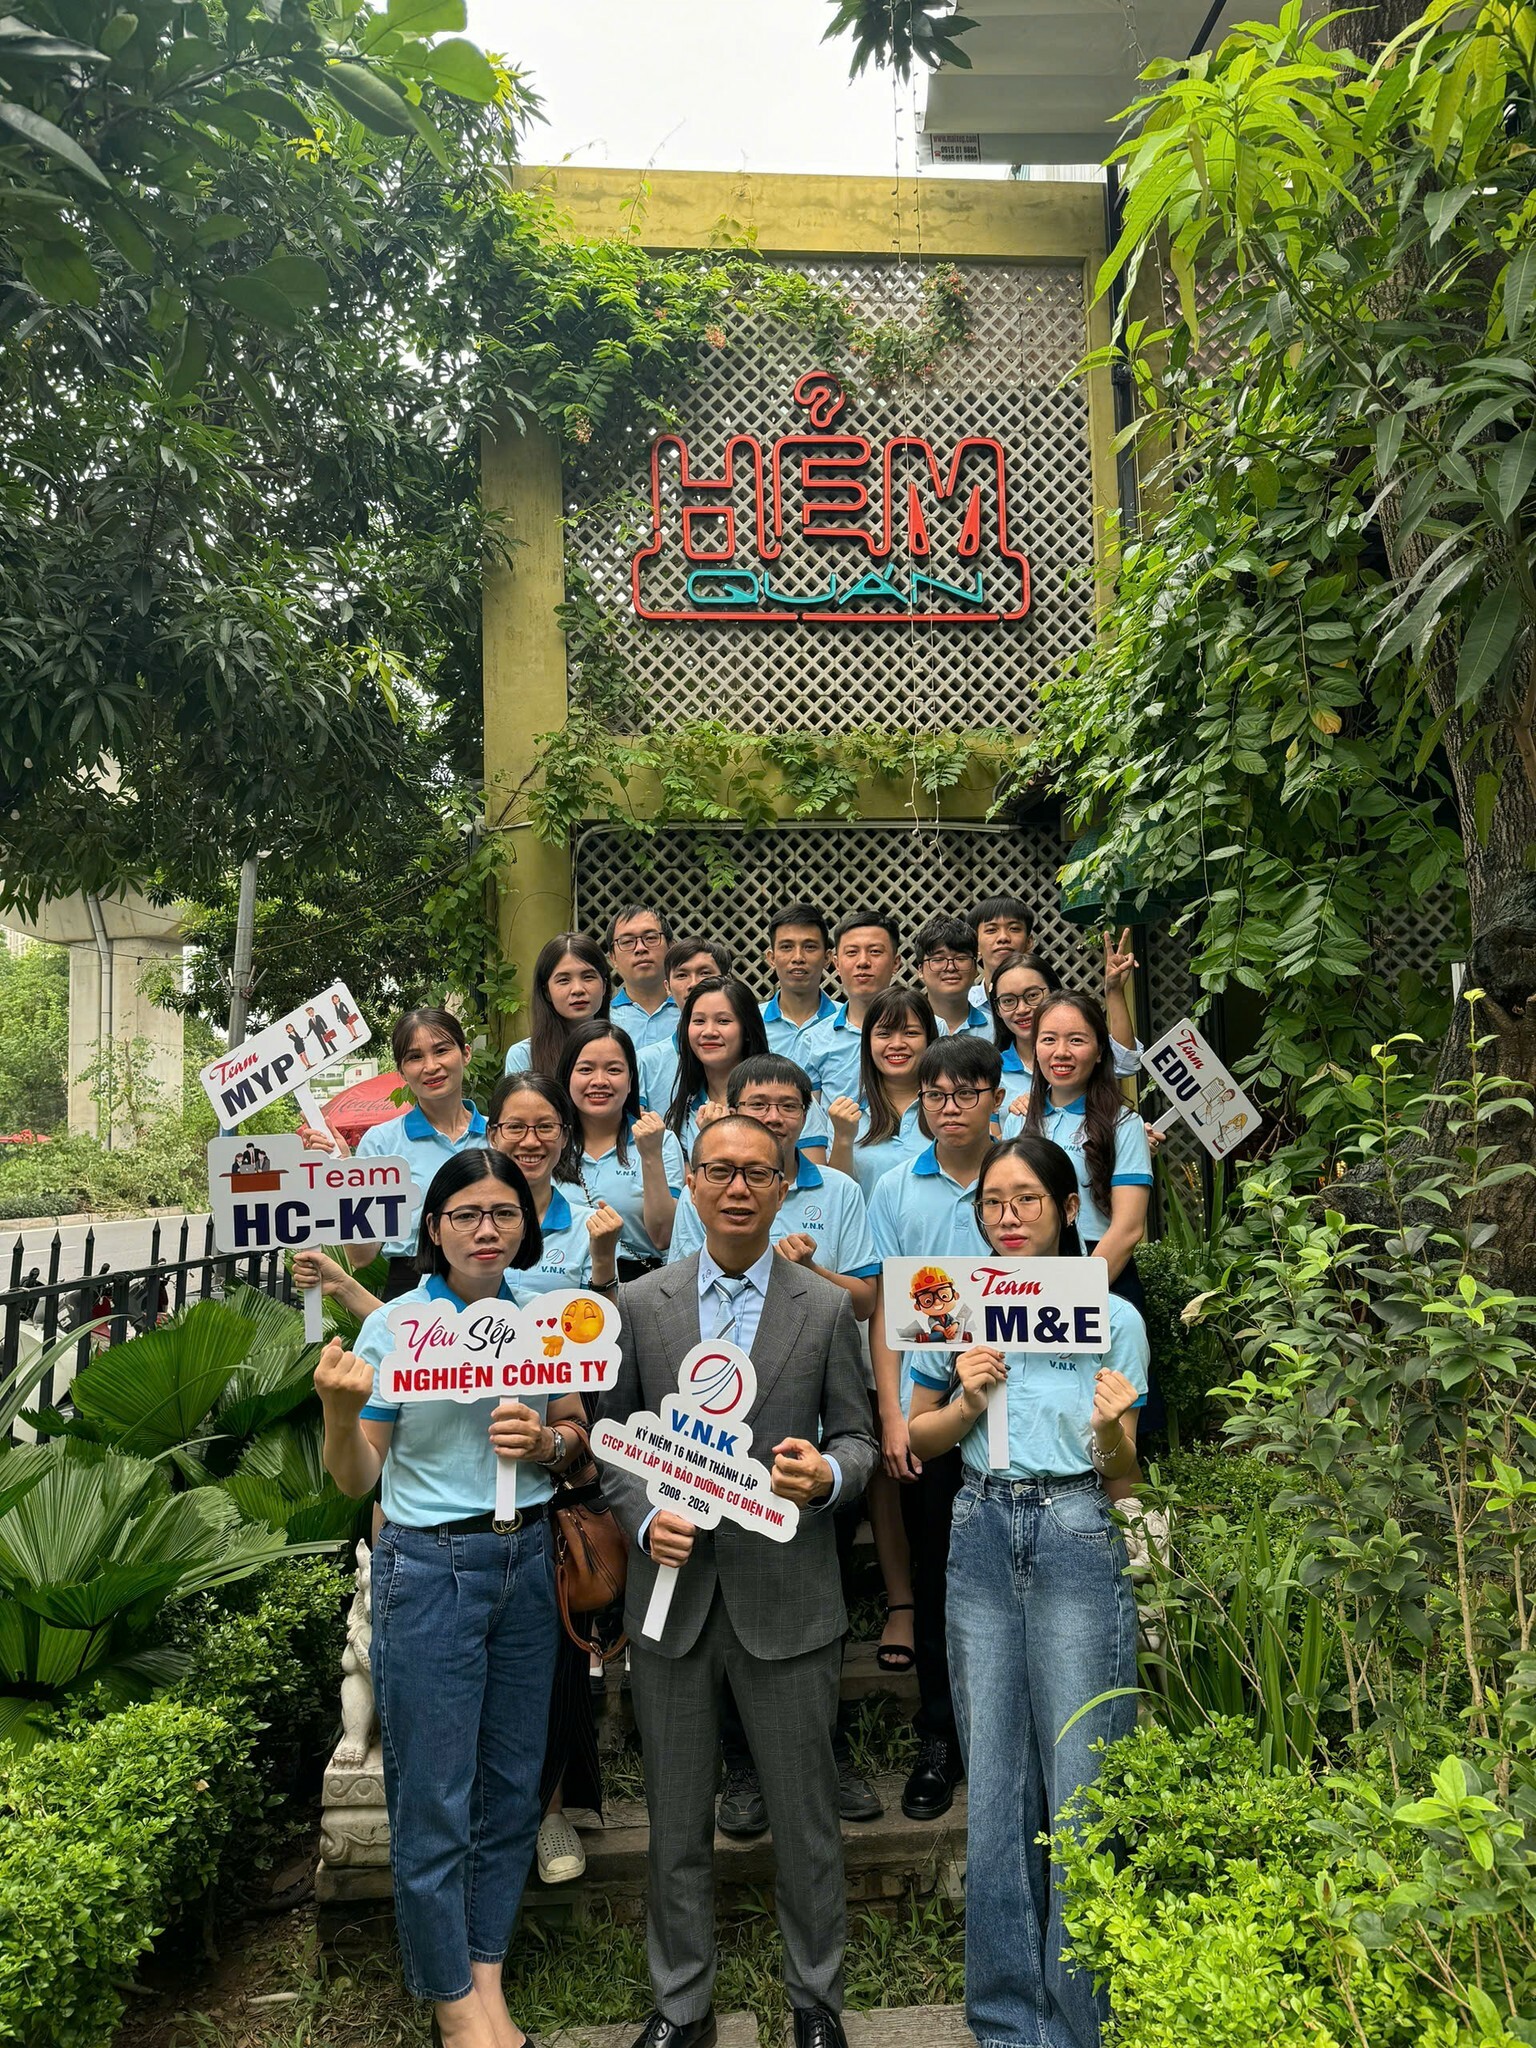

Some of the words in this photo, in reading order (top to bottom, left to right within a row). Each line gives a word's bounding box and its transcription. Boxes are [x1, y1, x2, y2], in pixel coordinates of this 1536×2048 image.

[686, 563, 984, 605] QUÁN
[209, 1052, 260, 1087] Team
[1176, 1028, 1205, 1071] Team
[220, 1053, 295, 1118] MYP
[1151, 1045, 1202, 1102] EDU
[299, 1162, 401, 1190] Team
[233, 1194, 407, 1248] HC-KT
[801, 1221, 825, 1232] V.N.K
[541, 1265, 566, 1275] V.N.K
[970, 1266, 1044, 1297] Team
[400, 1316, 460, 1363] Yêu
[463, 1315, 517, 1359] Sếp
[985, 1305, 1102, 1344] M&E
[393, 1361, 494, 1394] NGHIỆN
[502, 1359, 572, 1387] CÔNG
[580, 1360, 608, 1382] TY
[1049, 1359, 1077, 1372] V.N.K
[671, 1408, 739, 1457] V.N.K
[635, 1426, 649, 1442] KỶ
[648, 1432, 673, 1453] NIỆM
[673, 1444, 685, 1458] 16
[685, 1449, 708, 1469] NĂM
[708, 1459, 740, 1483] THÀNH
[739, 1473, 759, 1491] LẬP
[601, 1433, 624, 1452] CTCP
[624, 1443, 643, 1461] XÂY
[642, 1450, 661, 1469] LẮP
[661, 1460, 673, 1476] VÀ
[673, 1466, 693, 1485] BẢO
[693, 1475, 726, 1500] DƯỠNG
[726, 1490, 741, 1506] CƠ
[740, 1496, 764, 1517] ĐIỆN
[765, 1507, 785, 1527] VNK
[658, 1481, 681, 1502] 2008
[687, 1495, 711, 1515] 2024
